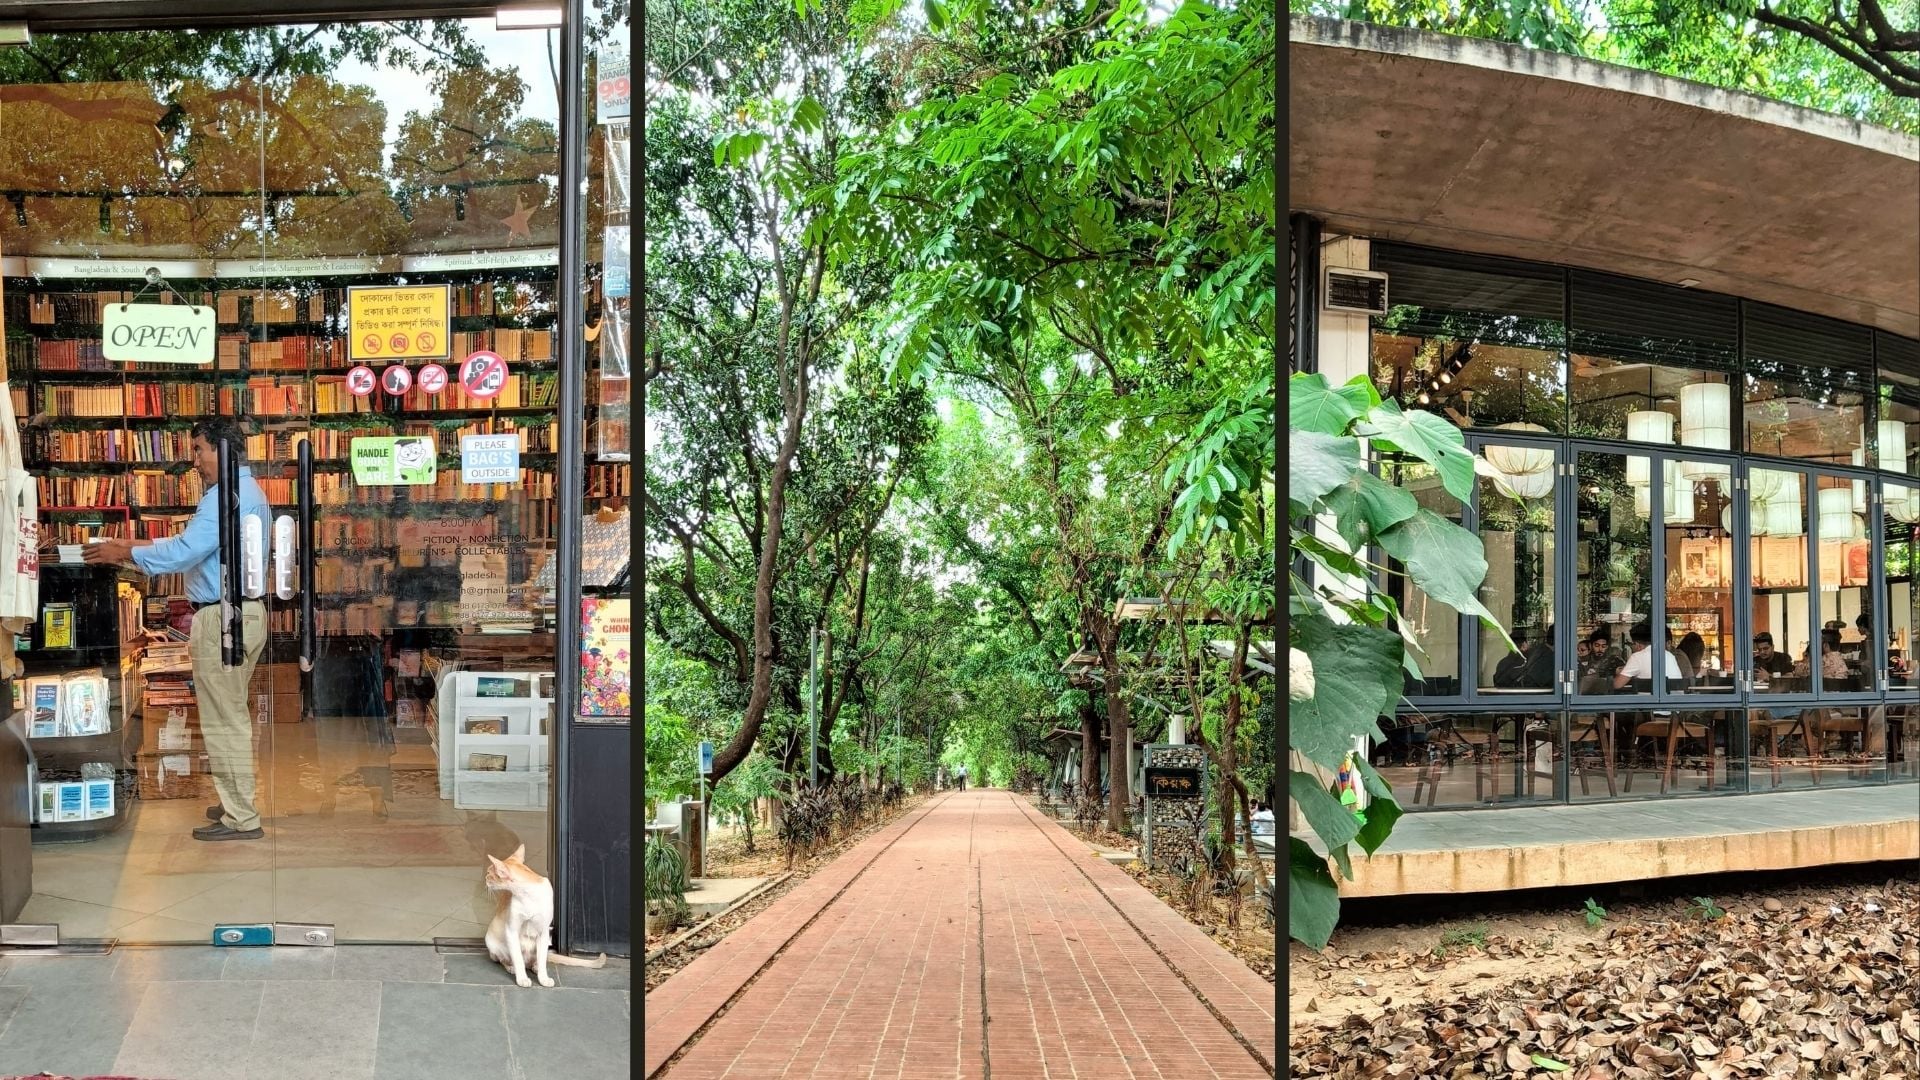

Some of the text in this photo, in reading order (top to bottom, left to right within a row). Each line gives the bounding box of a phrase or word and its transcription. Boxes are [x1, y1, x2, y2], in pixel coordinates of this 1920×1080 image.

[599, 77, 630, 99] 99
[74, 265, 111, 274] Bangladesh
[280, 263, 320, 273] Management
[331, 261, 366, 271] Leadership
[359, 294, 393, 303] দোকানের
[417, 292, 435, 301] কোন
[363, 305, 431, 316] প্রকার ছবি তোলা বা
[356, 320, 379, 330] ভিডিও
[112, 324, 207, 350] OPEN
[474, 441, 507, 449] PLEASE
[357, 448, 389, 457] HANDLE
[469, 451, 513, 465] BAG'S
[357, 471, 389, 481] CARE
[471, 469, 511, 477] OUTSIDE
[440, 517, 483, 528] 8:00PM
[335, 537, 374, 546] ORIGIN
[423, 536, 460, 544] FICTION
[469, 534, 529, 543] NONFICTION
[455, 546, 526, 556] COLLECTABLES
[247, 523, 258, 590] PULL
[281, 524, 291, 591] PULL
